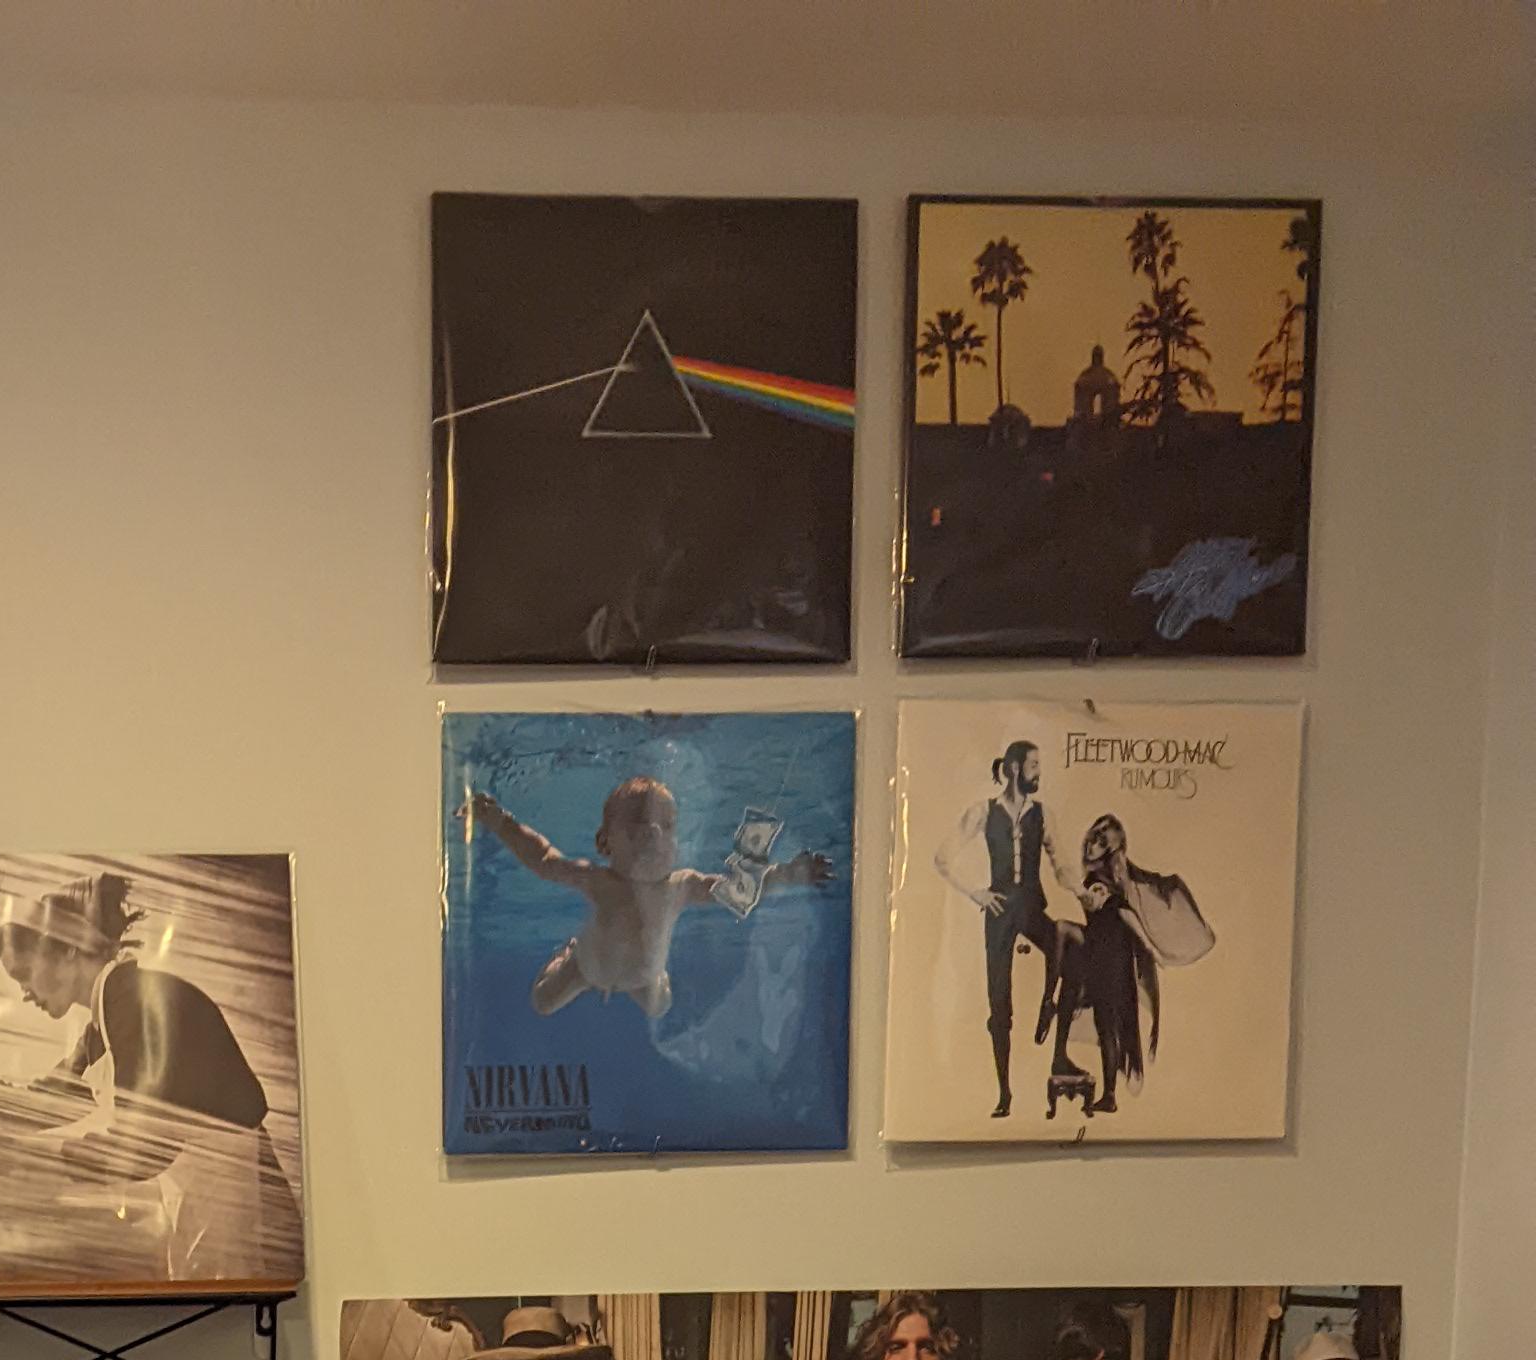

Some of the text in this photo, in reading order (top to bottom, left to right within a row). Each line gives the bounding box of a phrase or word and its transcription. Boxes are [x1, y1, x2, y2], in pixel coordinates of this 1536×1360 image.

[1066, 733, 1178, 768] FLEETWOOD
[1120, 767, 1197, 799] RUMOURS
[464, 1064, 590, 1107] NIRVANA
